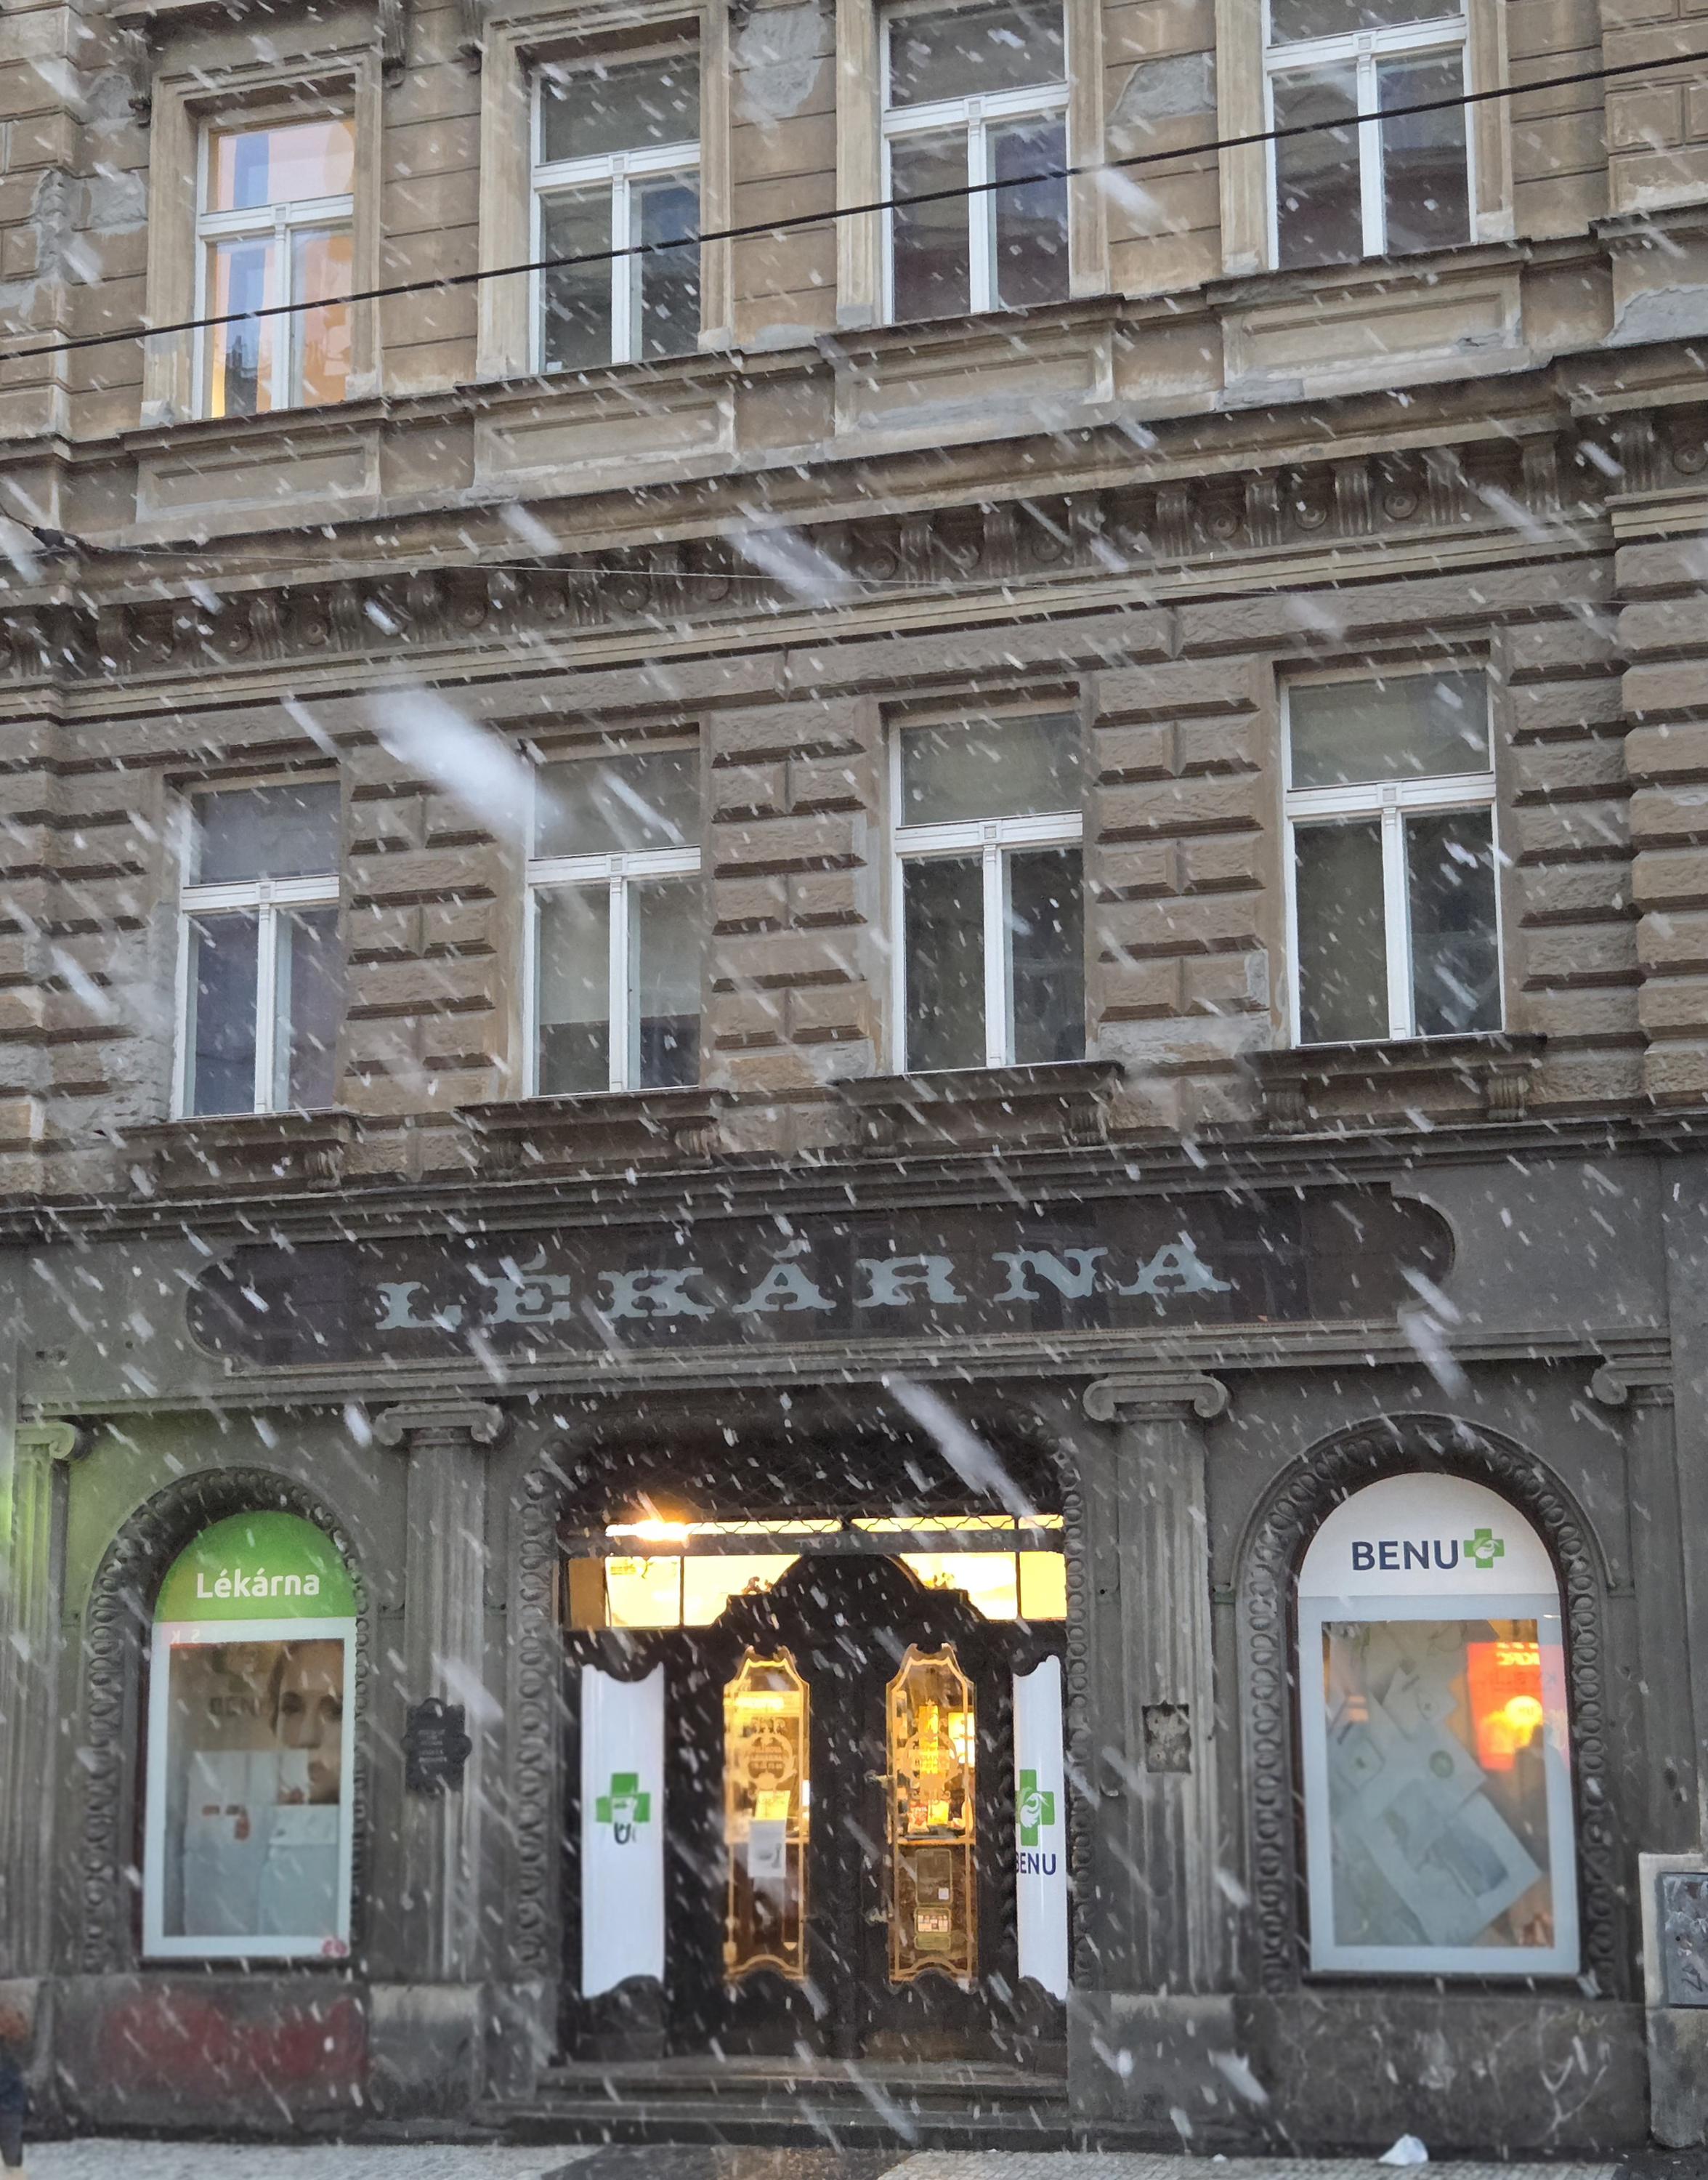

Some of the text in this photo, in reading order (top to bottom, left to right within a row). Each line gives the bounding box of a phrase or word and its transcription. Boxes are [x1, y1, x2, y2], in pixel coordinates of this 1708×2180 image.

[375, 1240, 1232, 1330] LÉKÁRNA
[1352, 1540, 1458, 1570] BENU
[197, 1567, 320, 1598] Lékárna
